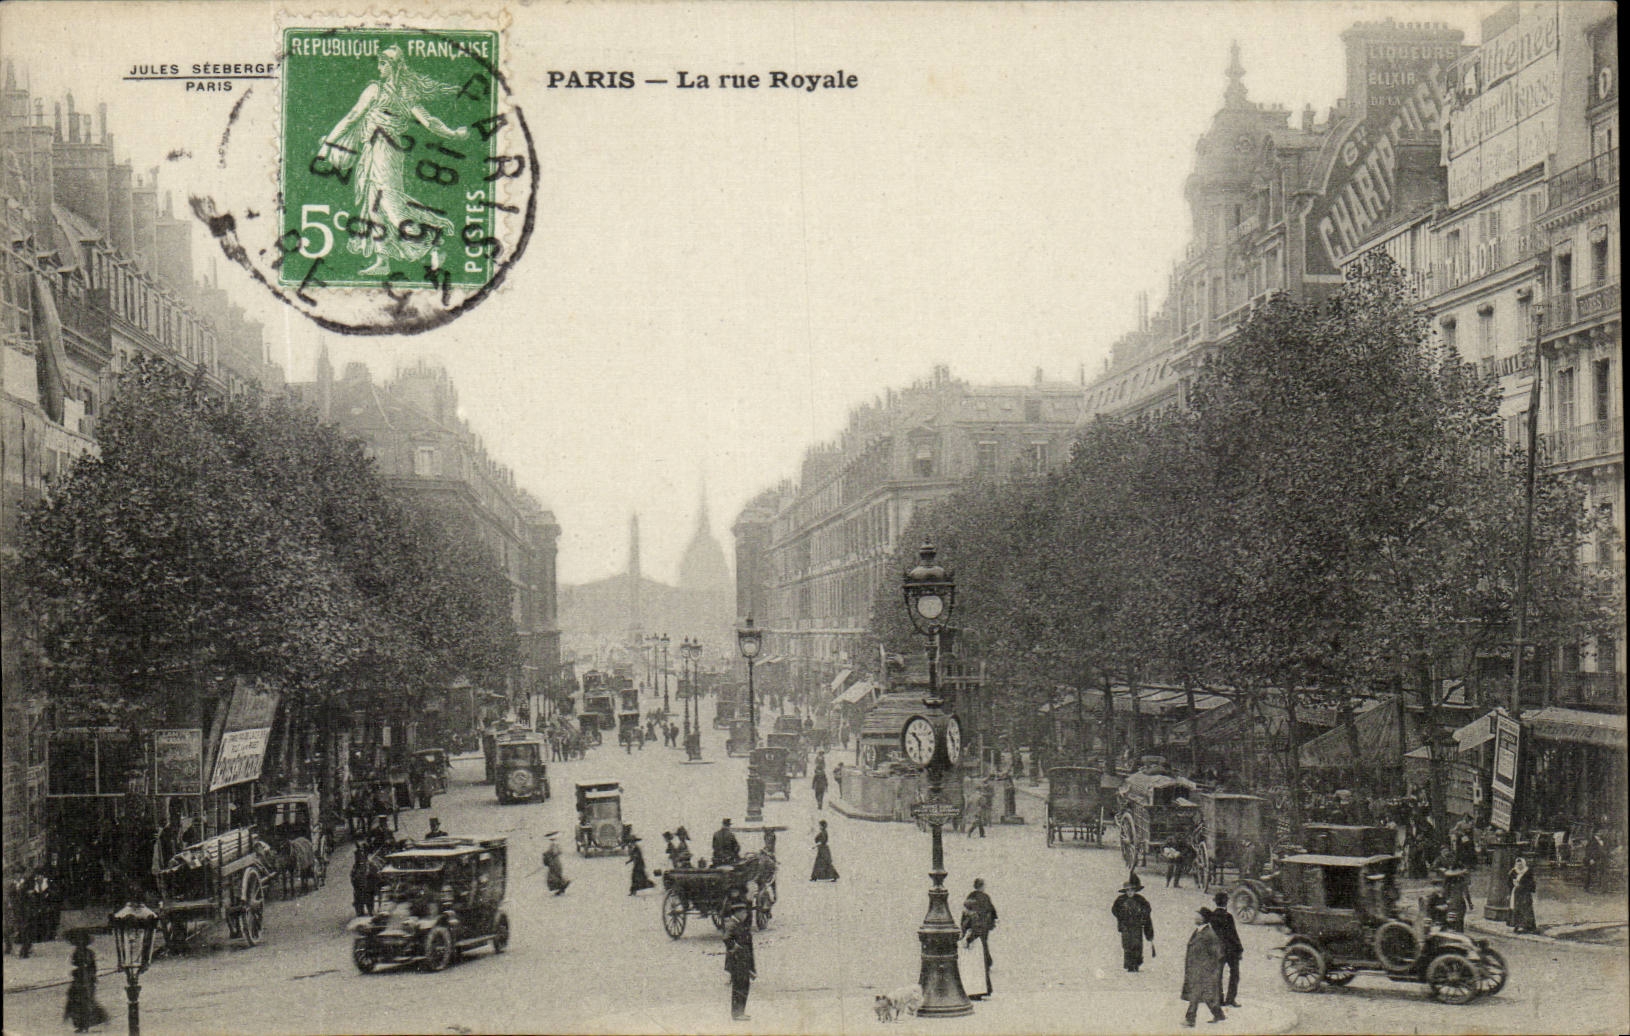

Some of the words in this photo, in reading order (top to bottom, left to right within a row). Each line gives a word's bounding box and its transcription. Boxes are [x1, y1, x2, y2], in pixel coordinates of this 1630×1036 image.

[407, 38, 490, 60] FRANÇAISE
[1368, 45, 1457, 60] LIQUEURS
[1368, 71, 1416, 86] ELIXIR
[464, 189, 487, 274] POSTES
